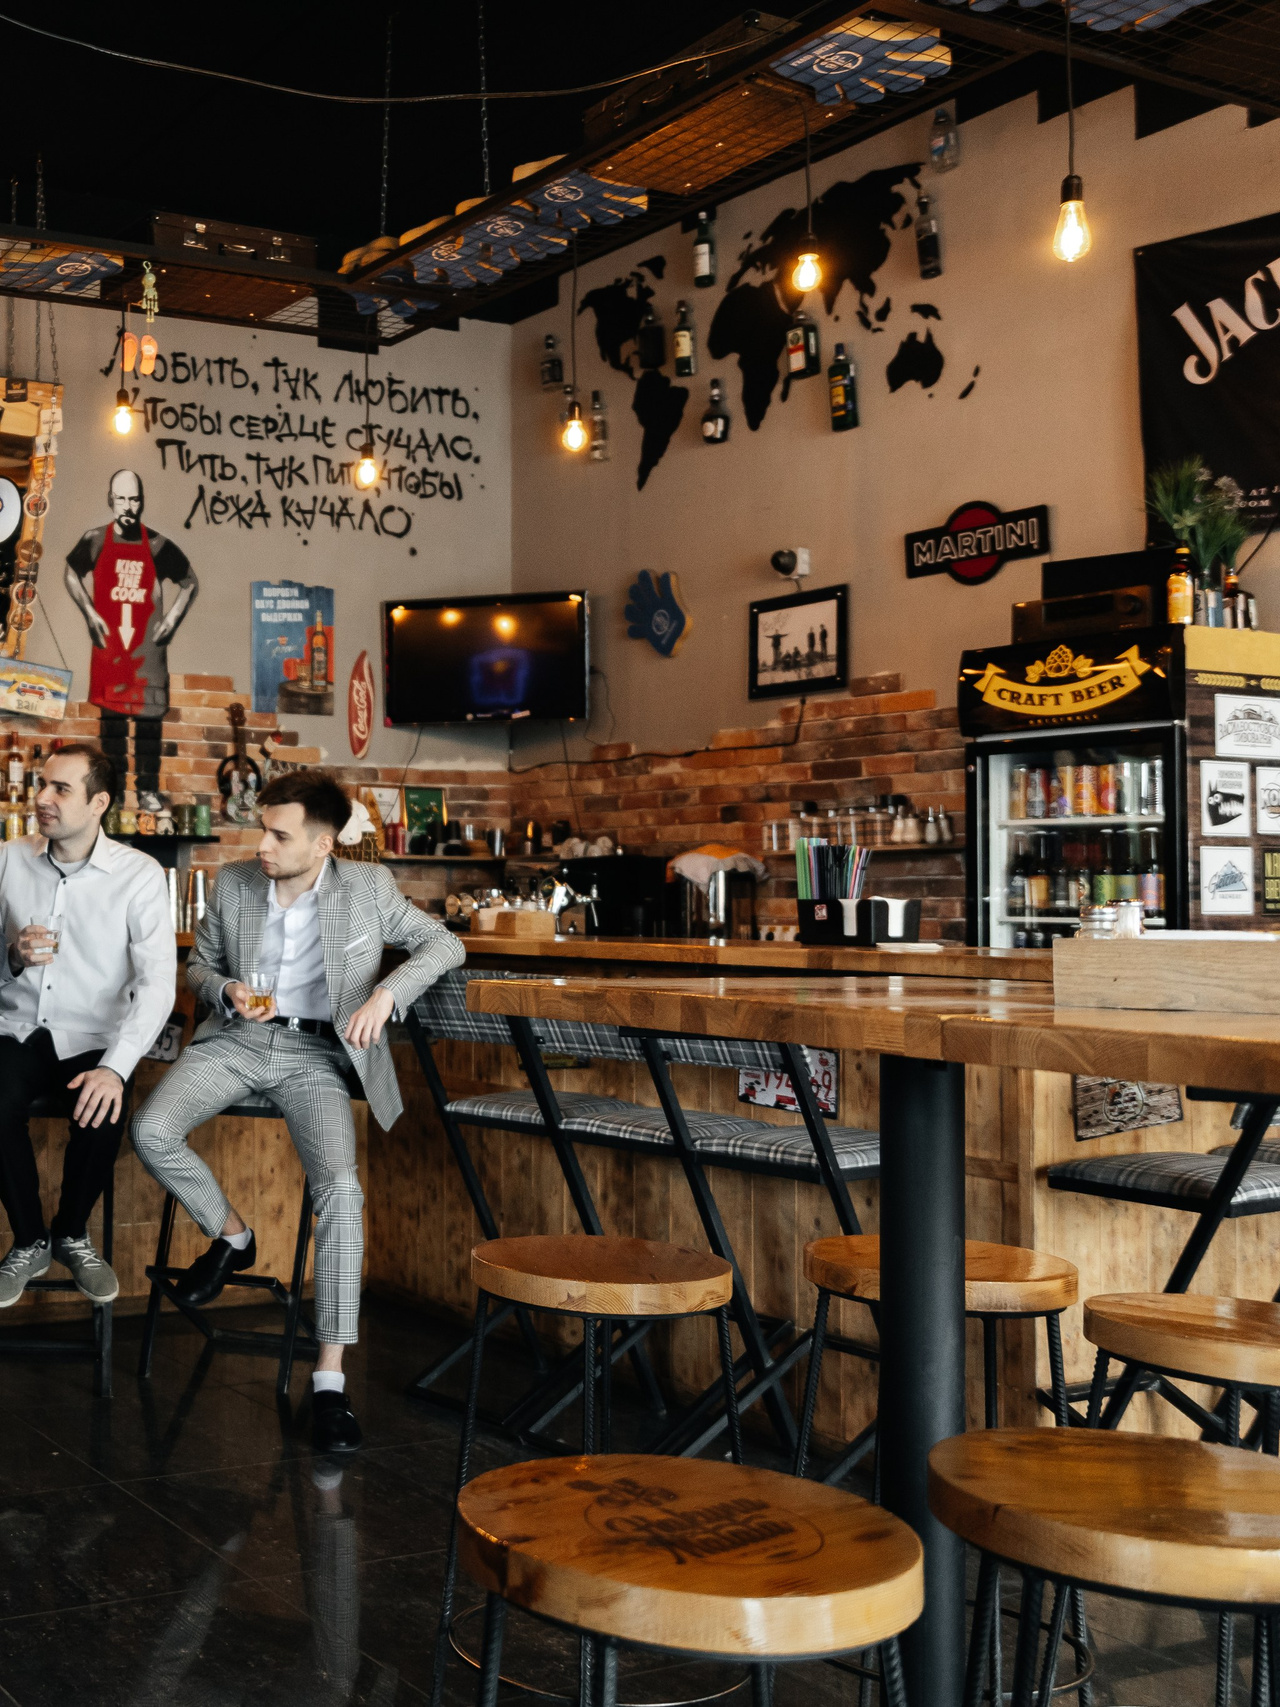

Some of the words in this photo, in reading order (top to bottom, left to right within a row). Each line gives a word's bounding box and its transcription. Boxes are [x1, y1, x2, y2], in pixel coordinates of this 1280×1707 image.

[1171, 256, 1280, 385] JAC
[913, 517, 1040, 568] MARTINI
[115, 559, 144, 575] KISS
[118, 572, 141, 588] THE
[111, 586, 147, 603] COOK
[995, 687, 1064, 707] CRAFT
[1070, 675, 1126, 704] BEER
[16, 699, 39, 712] Bali
